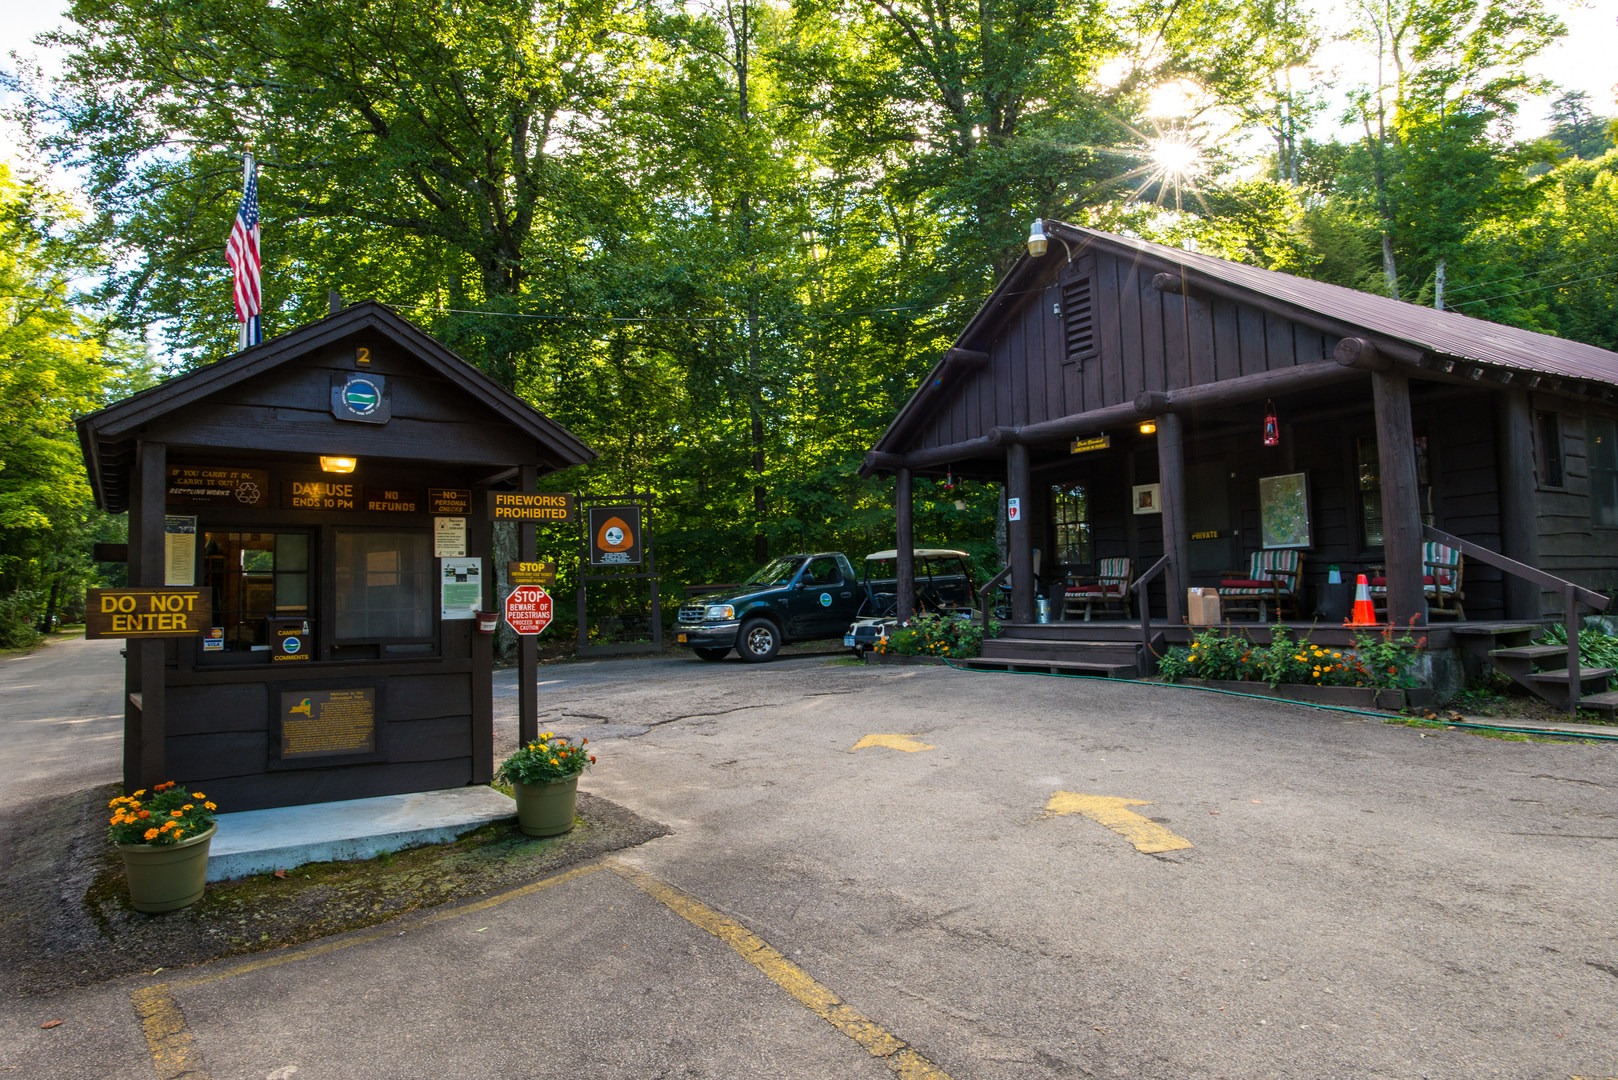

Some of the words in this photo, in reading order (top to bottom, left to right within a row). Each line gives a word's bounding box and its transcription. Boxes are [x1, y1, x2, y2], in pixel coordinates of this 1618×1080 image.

[358, 348, 370, 363] 2
[292, 482, 320, 496] DAY
[326, 484, 353, 497] USE
[443, 491, 457, 499] NO
[385, 491, 398, 500] NO
[496, 494, 566, 507] FIREWORKS
[293, 498, 320, 507] ENDS
[324, 499, 334, 508] 10
[337, 499, 353, 508] PM
[369, 501, 415, 511] REFUNDS
[495, 508, 567, 519] PROHIBITED
[1192, 531, 1218, 539] PRIVATE
[520, 562, 545, 572] STOP
[514, 591, 544, 602] STOP
[101, 595, 137, 613] DO
[150, 595, 198, 612] NOT
[112, 613, 187, 631] ENTER
